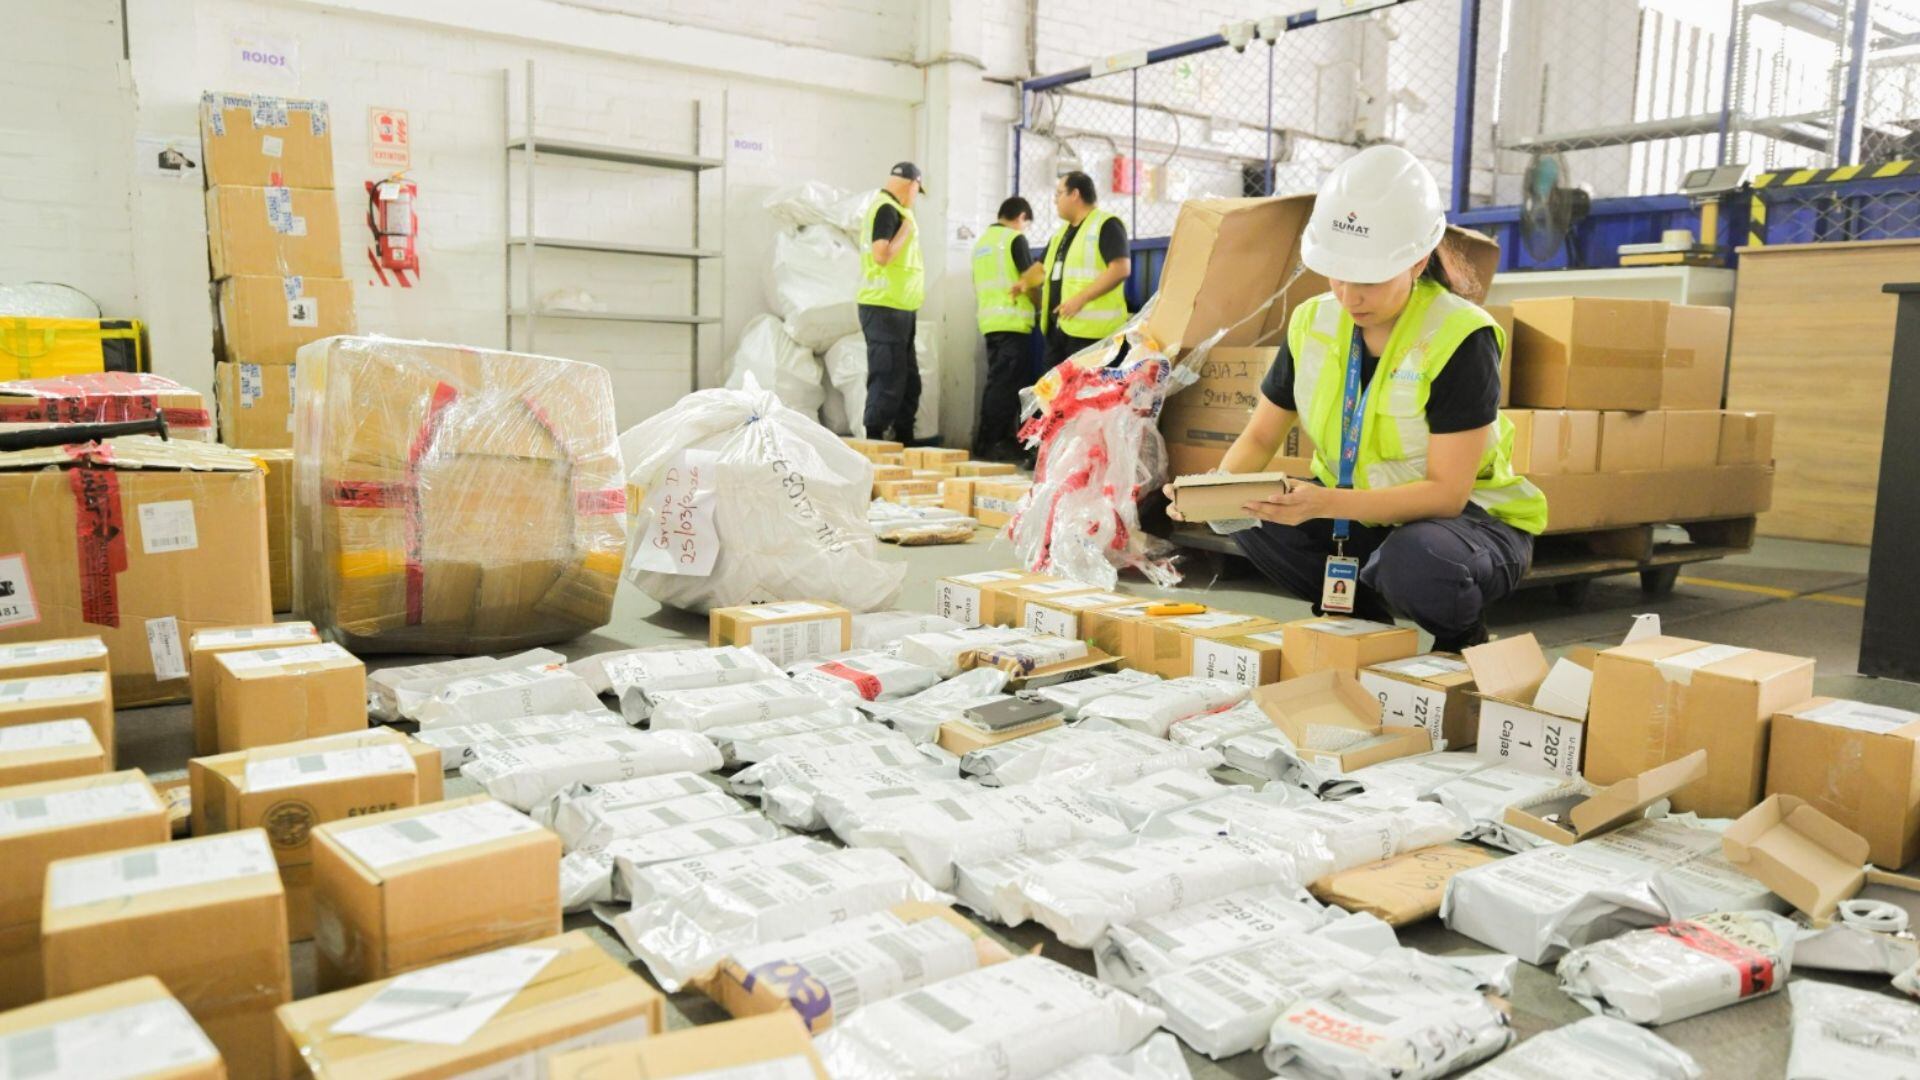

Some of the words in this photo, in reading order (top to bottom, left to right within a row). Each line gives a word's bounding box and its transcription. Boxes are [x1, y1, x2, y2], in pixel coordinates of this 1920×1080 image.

[242, 51, 285, 67] ROJOS
[1332, 219, 1369, 234] SUNAT
[1235, 360, 1248, 377] 2
[652, 494, 673, 550] Grupo
[665, 467, 679, 486] D
[1219, 668, 1229, 676] 1
[1499, 720, 1513, 757] Cajas
[1544, 726, 1561, 771] 7287
[1215, 898, 1276, 932] 72919
